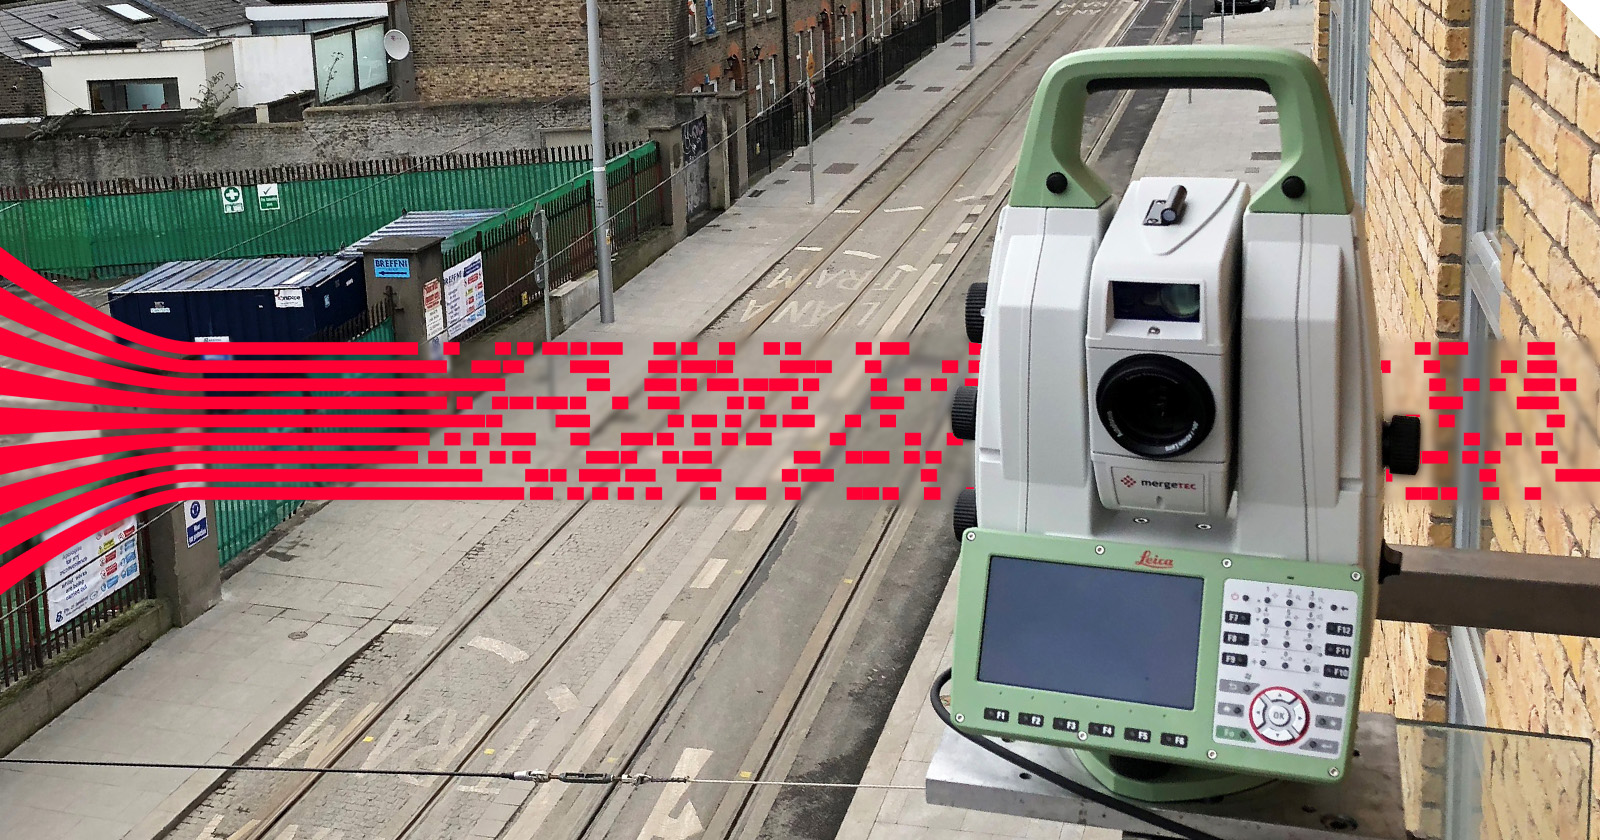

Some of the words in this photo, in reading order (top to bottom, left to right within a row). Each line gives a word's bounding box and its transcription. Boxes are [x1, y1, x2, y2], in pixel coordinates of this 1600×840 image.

[375, 259, 408, 268] BREFFNI
[766, 267, 902, 291] TRAM
[1141, 479, 1197, 490] mergeTEC
[1135, 550, 1174, 569] Leica
[1336, 625, 1351, 635] F12
[1335, 646, 1350, 655] F11
[996, 711, 1006, 720] F1
[1273, 711, 1285, 720] OK
[1031, 716, 1041, 725] F2
[1066, 721, 1077, 730] F3
[1102, 726, 1112, 735] F4
[1138, 731, 1149, 740] F5
[1175, 736, 1185, 745] F6
